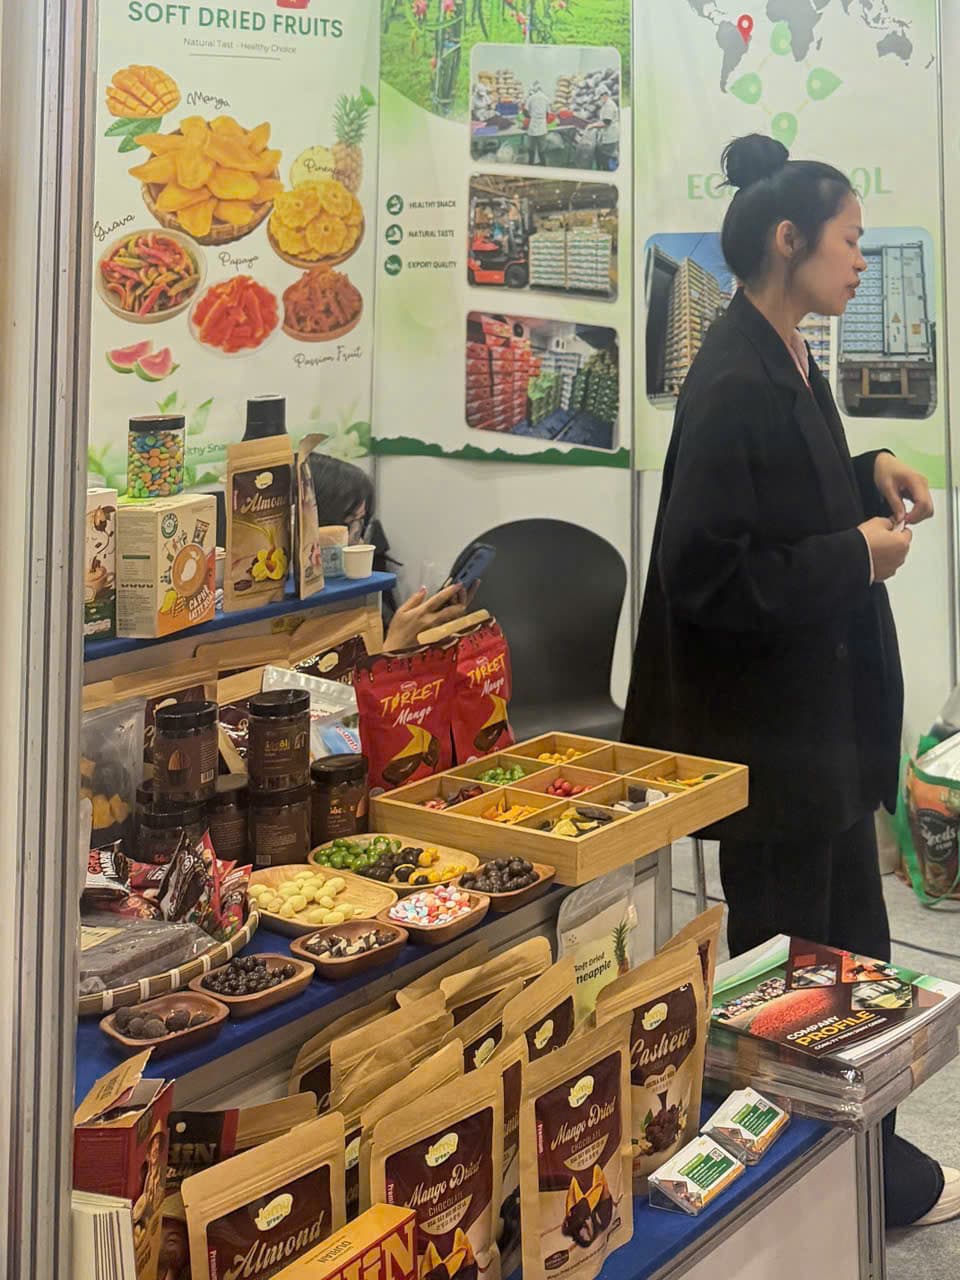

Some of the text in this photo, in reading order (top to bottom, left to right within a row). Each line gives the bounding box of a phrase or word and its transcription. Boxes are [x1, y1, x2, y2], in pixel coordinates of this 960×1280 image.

[128, 1, 343, 38] SOFT DRIED FRUITS
[184, 38, 215, 48] Natural
[241, 41, 269, 54] Healthy
[92, 214, 136, 241] Guava
[219, 252, 259, 271] Papaya
[392, 705, 432, 728] Mango
[576, 959, 612, 984] neapple
[786, 1015, 840, 1041] COMPANY
[795, 1010, 876, 1047] PROFILE
[631, 1028, 691, 1068] Cashew
[551, 1096, 617, 1151] Mango Dried
[403, 1154, 483, 1208] Mango Dried
[223, 1209, 325, 1280] Almond
